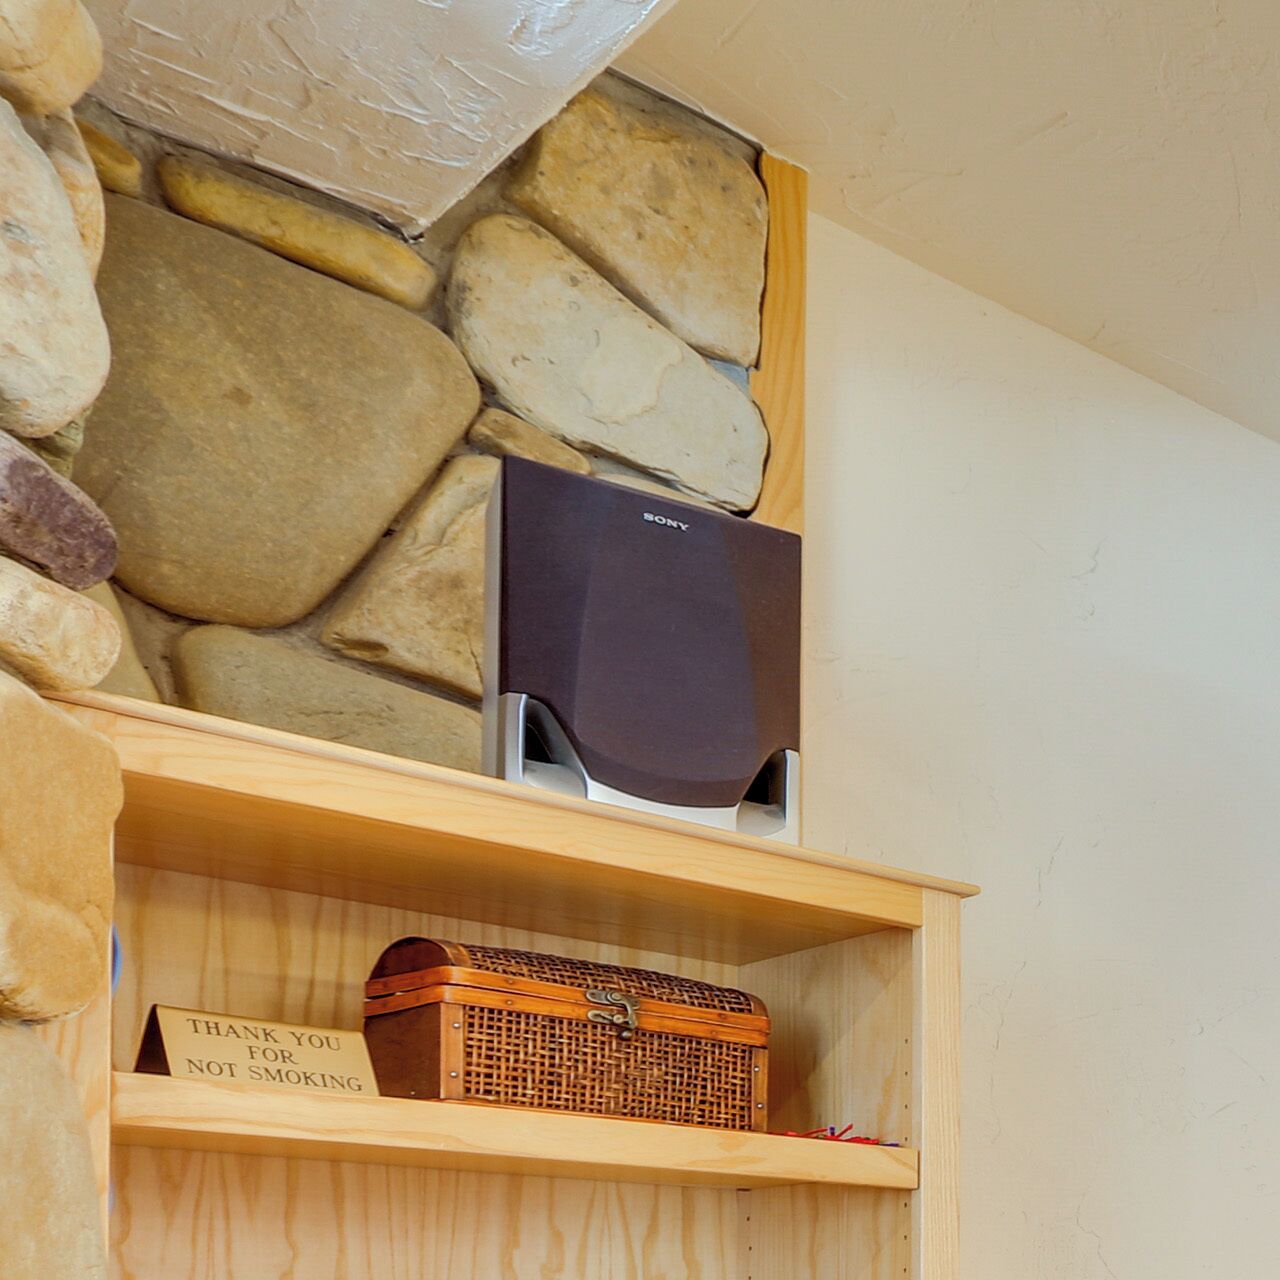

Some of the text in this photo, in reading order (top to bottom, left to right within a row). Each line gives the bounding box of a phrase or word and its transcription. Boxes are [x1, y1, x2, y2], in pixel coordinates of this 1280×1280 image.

[642, 512, 689, 532] SONY
[185, 1018, 341, 1052] THANK YOU
[246, 1045, 299, 1065] FOR
[185, 1058, 363, 1092] NOT SMOKING
